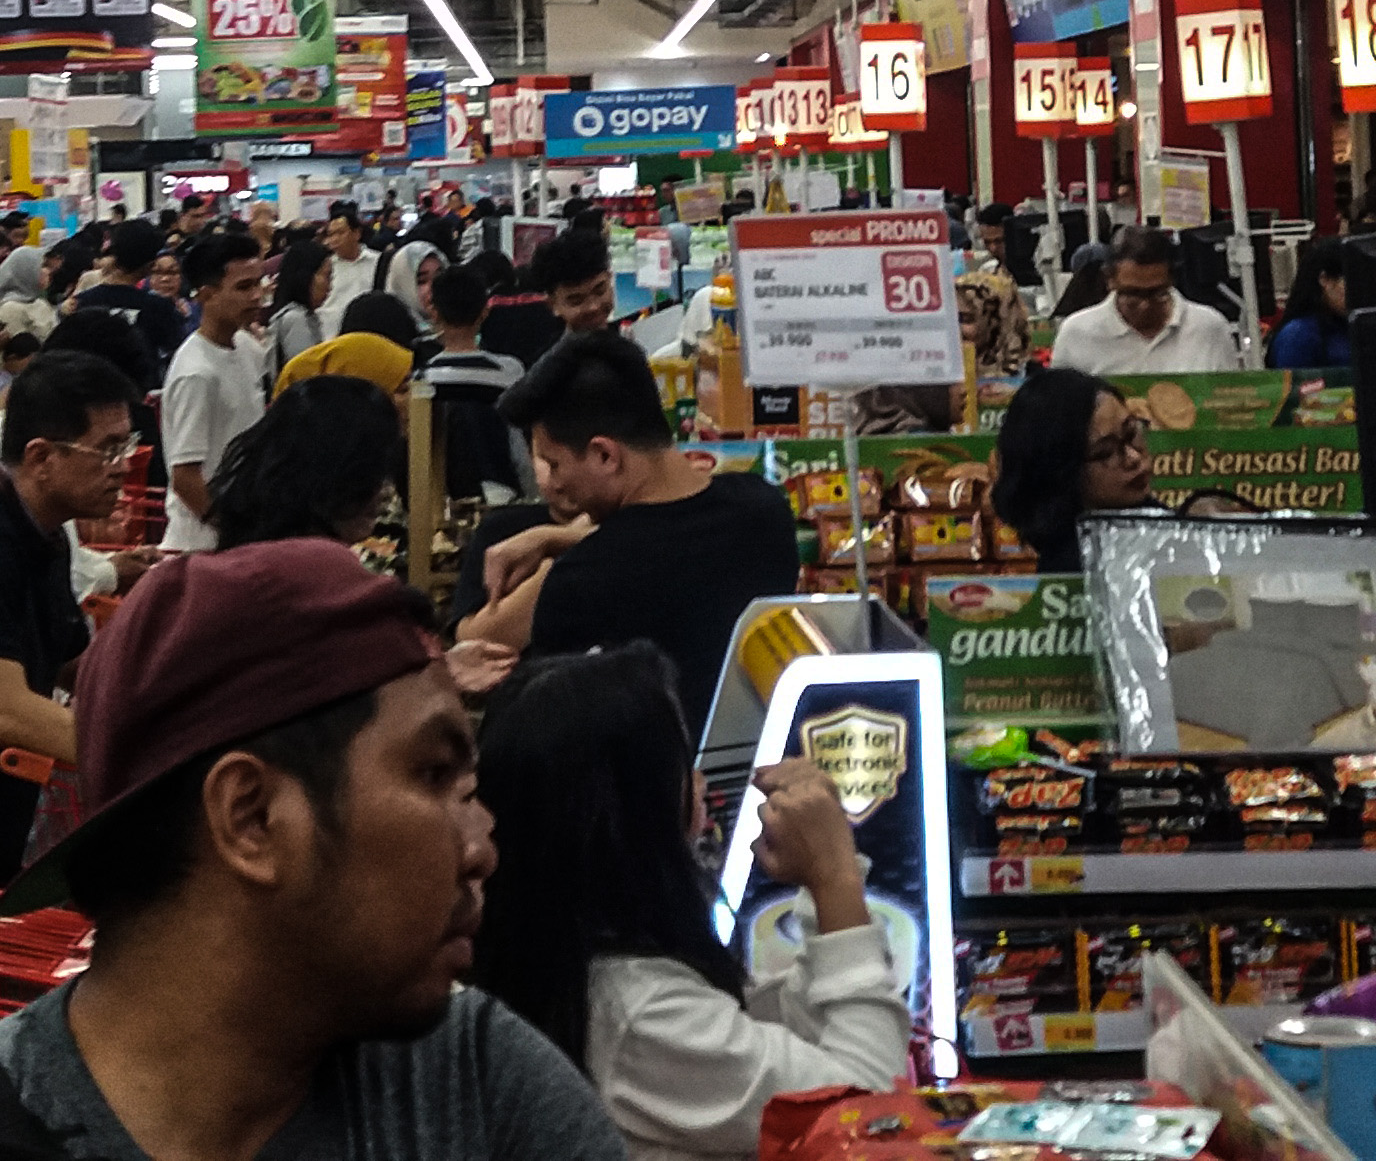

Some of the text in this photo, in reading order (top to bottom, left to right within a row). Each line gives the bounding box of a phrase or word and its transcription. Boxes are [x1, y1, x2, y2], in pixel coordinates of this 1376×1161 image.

[1184, 23, 1236, 87] 17
[867, 52, 911, 102] 16
[1020, 68, 1057, 112] 15
[802, 88, 828, 125] 13
[1076, 77, 1109, 114] 14
[609, 103, 709, 136] gopay
[866, 218, 940, 242] PROMO
[888, 274, 931, 310] 30
[1152, 447, 1195, 476] ati
[1201, 444, 1308, 477] Sensasi
[1236, 480, 1346, 509] Butter!
[1041, 582, 1093, 620] Sa
[948, 619, 1096, 666] gandu
[864, 731, 895, 748] for
[838, 777, 895, 796] vices
